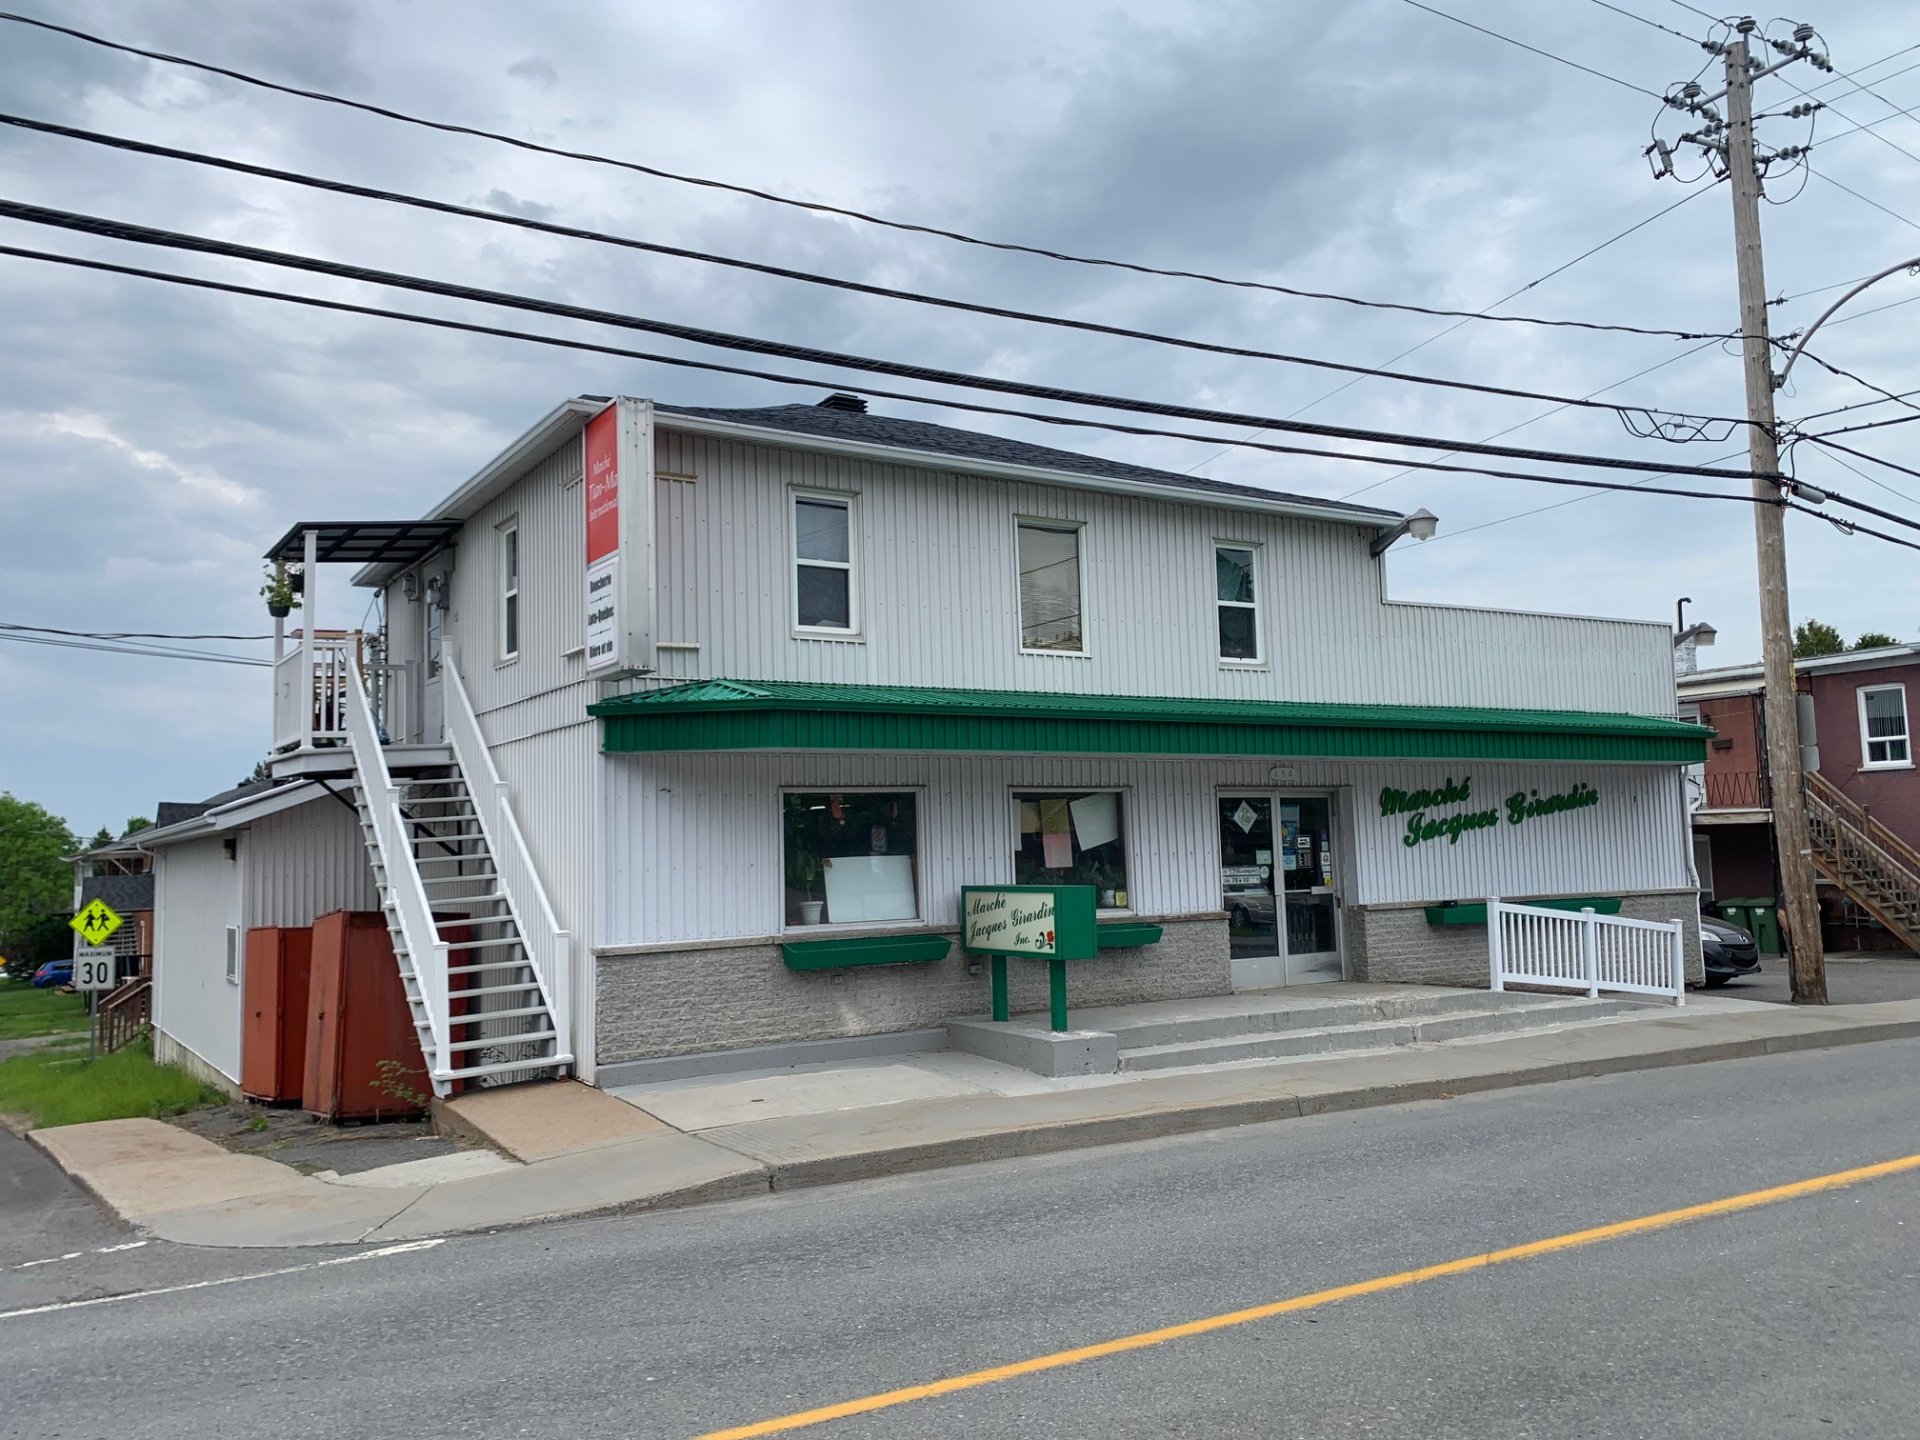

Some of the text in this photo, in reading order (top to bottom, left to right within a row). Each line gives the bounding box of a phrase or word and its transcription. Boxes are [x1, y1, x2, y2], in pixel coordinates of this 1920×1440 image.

[1380, 776, 1471, 817] Marché
[1403, 782, 1599, 848] Jacques Girardin
[967, 892, 1006, 917] Marché
[969, 901, 1055, 945] Jacques Girardin
[1013, 932, 1031, 947] Inc.
[82, 962, 108, 985] 30
